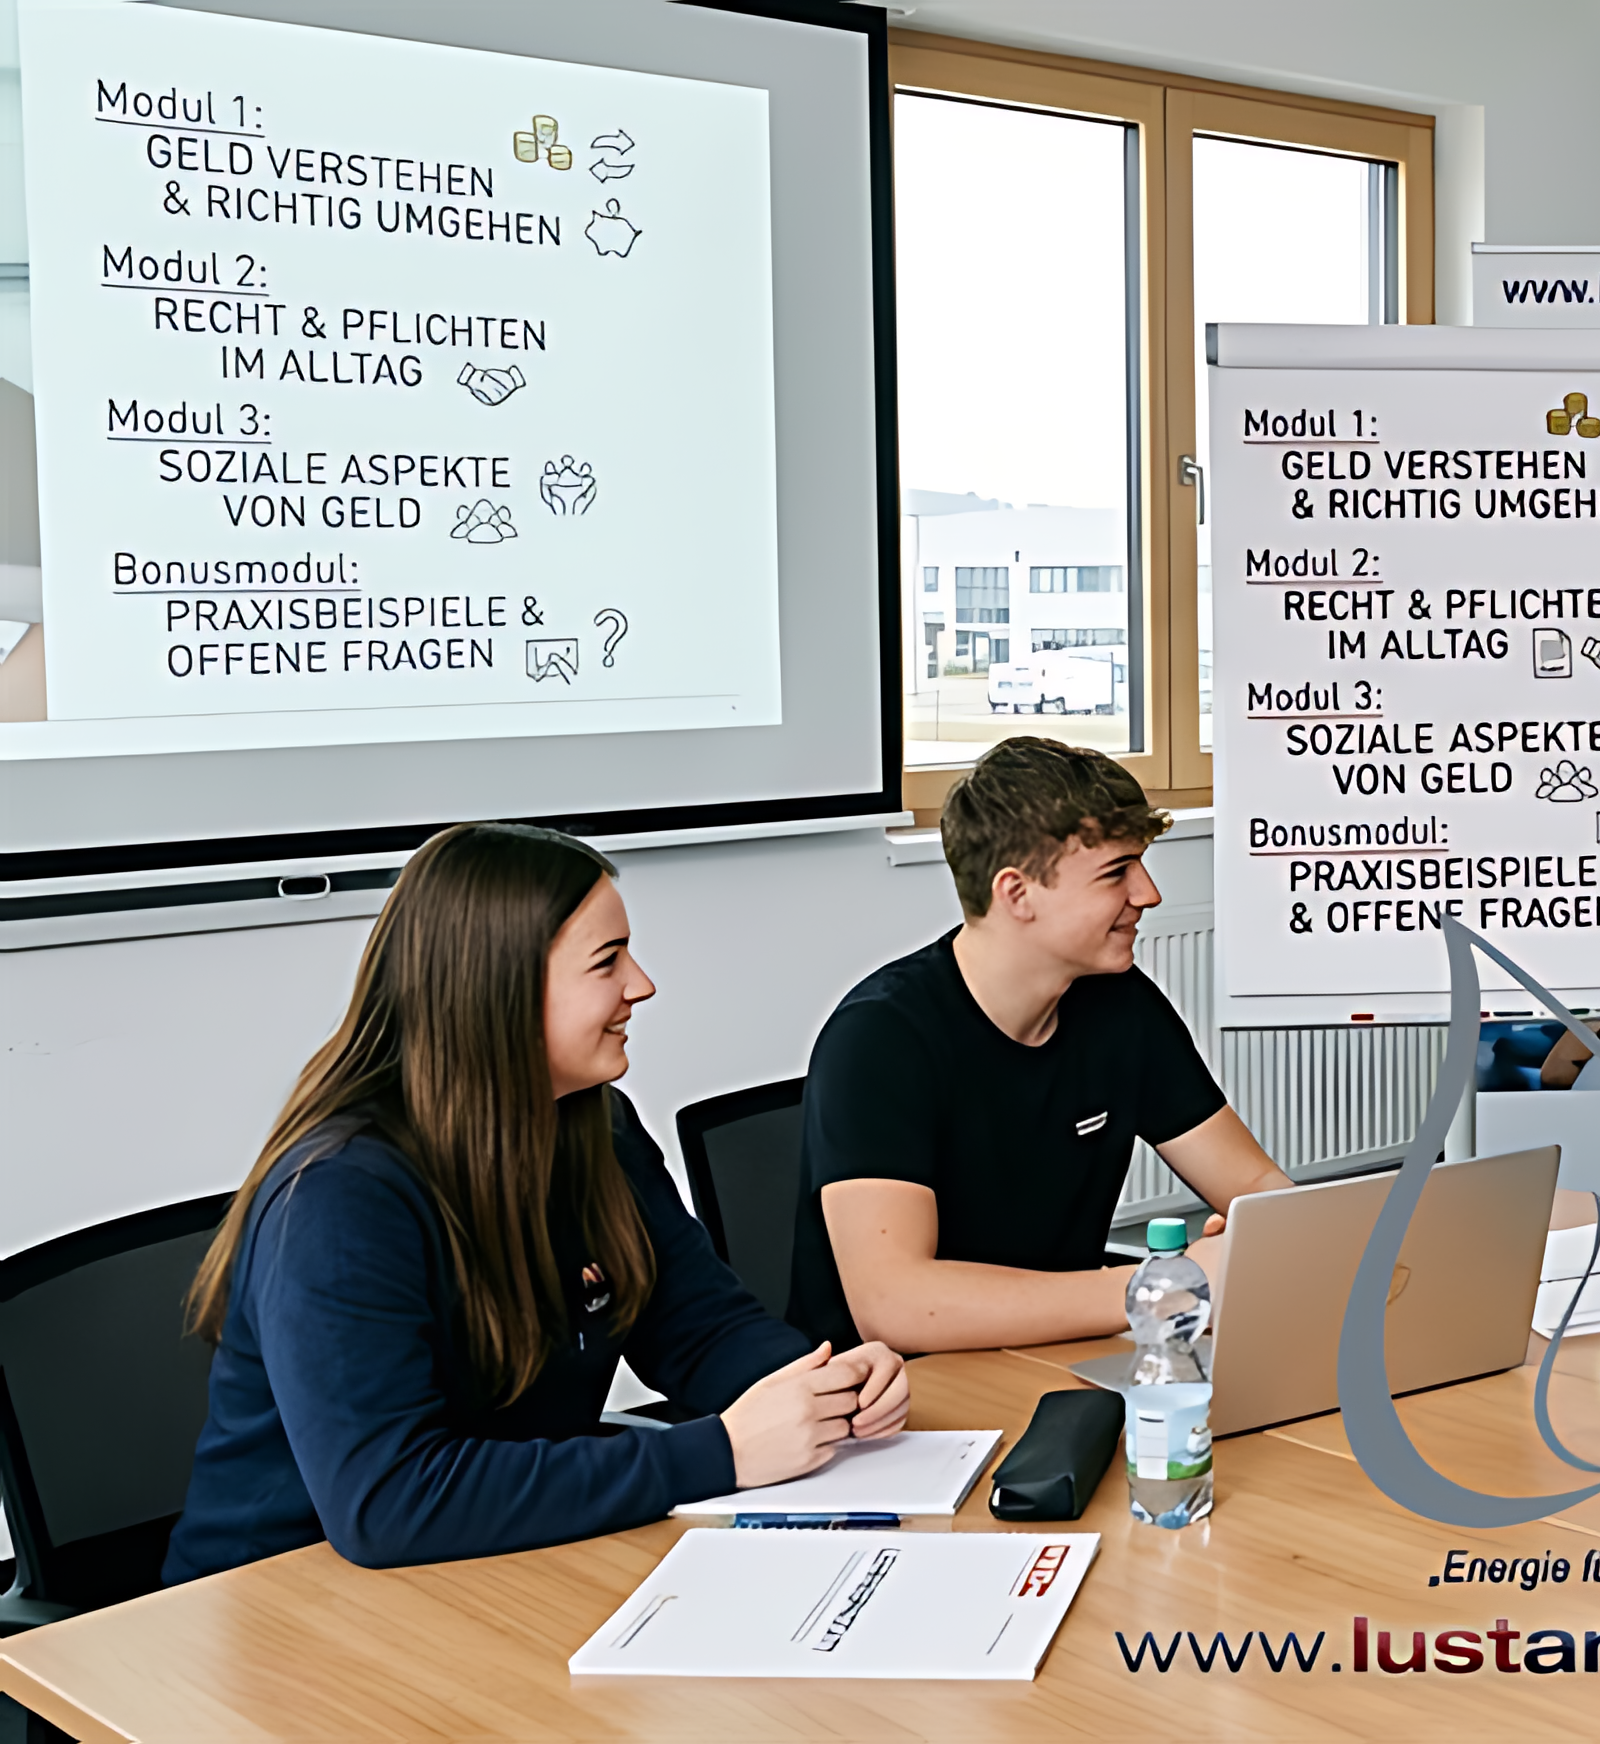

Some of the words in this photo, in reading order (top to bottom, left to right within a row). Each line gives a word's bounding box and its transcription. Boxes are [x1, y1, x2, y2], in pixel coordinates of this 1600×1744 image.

[96, 80, 218, 126] Modul
[233, 96, 261, 128] 1:
[147, 134, 252, 175] GELD
[268, 146, 493, 198] VERSTEHEN
[164, 181, 190, 215] &
[208, 185, 360, 229] RICHTIG
[378, 201, 560, 245] UMGEHEN
[104, 245, 220, 284] Modul
[236, 255, 266, 287] 2:
[155, 297, 286, 335] RECHT
[302, 307, 326, 338] &
[344, 309, 545, 350] PFLICHTEN
[223, 346, 263, 379] IM
[280, 350, 422, 386] ALLTAG
[109, 399, 223, 434] Modul
[240, 404, 269, 435] 3:
[1245, 409, 1336, 437] Modul
[1353, 410, 1376, 436] 1:
[160, 450, 326, 484] SOZIALE
[341, 455, 510, 487] ASPEKTE
[1282, 451, 1370, 480] GELD
[1384, 450, 1585, 479] VERSTEHEN
[223, 495, 305, 527] VON
[322, 496, 420, 528] GELD
[1292, 489, 1313, 519] &
[1330, 489, 1460, 519] RICHTIG
[115, 552, 357, 584] Bonusmodul:
[1247, 549, 1338, 577] Modul
[1353, 548, 1379, 576] 2:
[168, 597, 506, 631] PRAXISBEISPIELE
[522, 596, 543, 626] &
[1285, 590, 1394, 620] RECHT
[1409, 589, 1431, 620] &
[168, 642, 326, 677] OFFENE
[344, 638, 492, 671] FRAGEN
[1329, 630, 1365, 659] IM
[1381, 629, 1508, 659] ALLTAG
[1248, 682, 1339, 711] Modul
[1355, 680, 1381, 710] 3:
[1287, 723, 1433, 755] SOZIALE
[1333, 764, 1405, 795] VON
[1421, 762, 1512, 794] GELD
[1250, 816, 1447, 847] Bonusmodul:
[1291, 855, 1597, 891] PRAXISBEISPIELE
[1290, 902, 1312, 933] &
